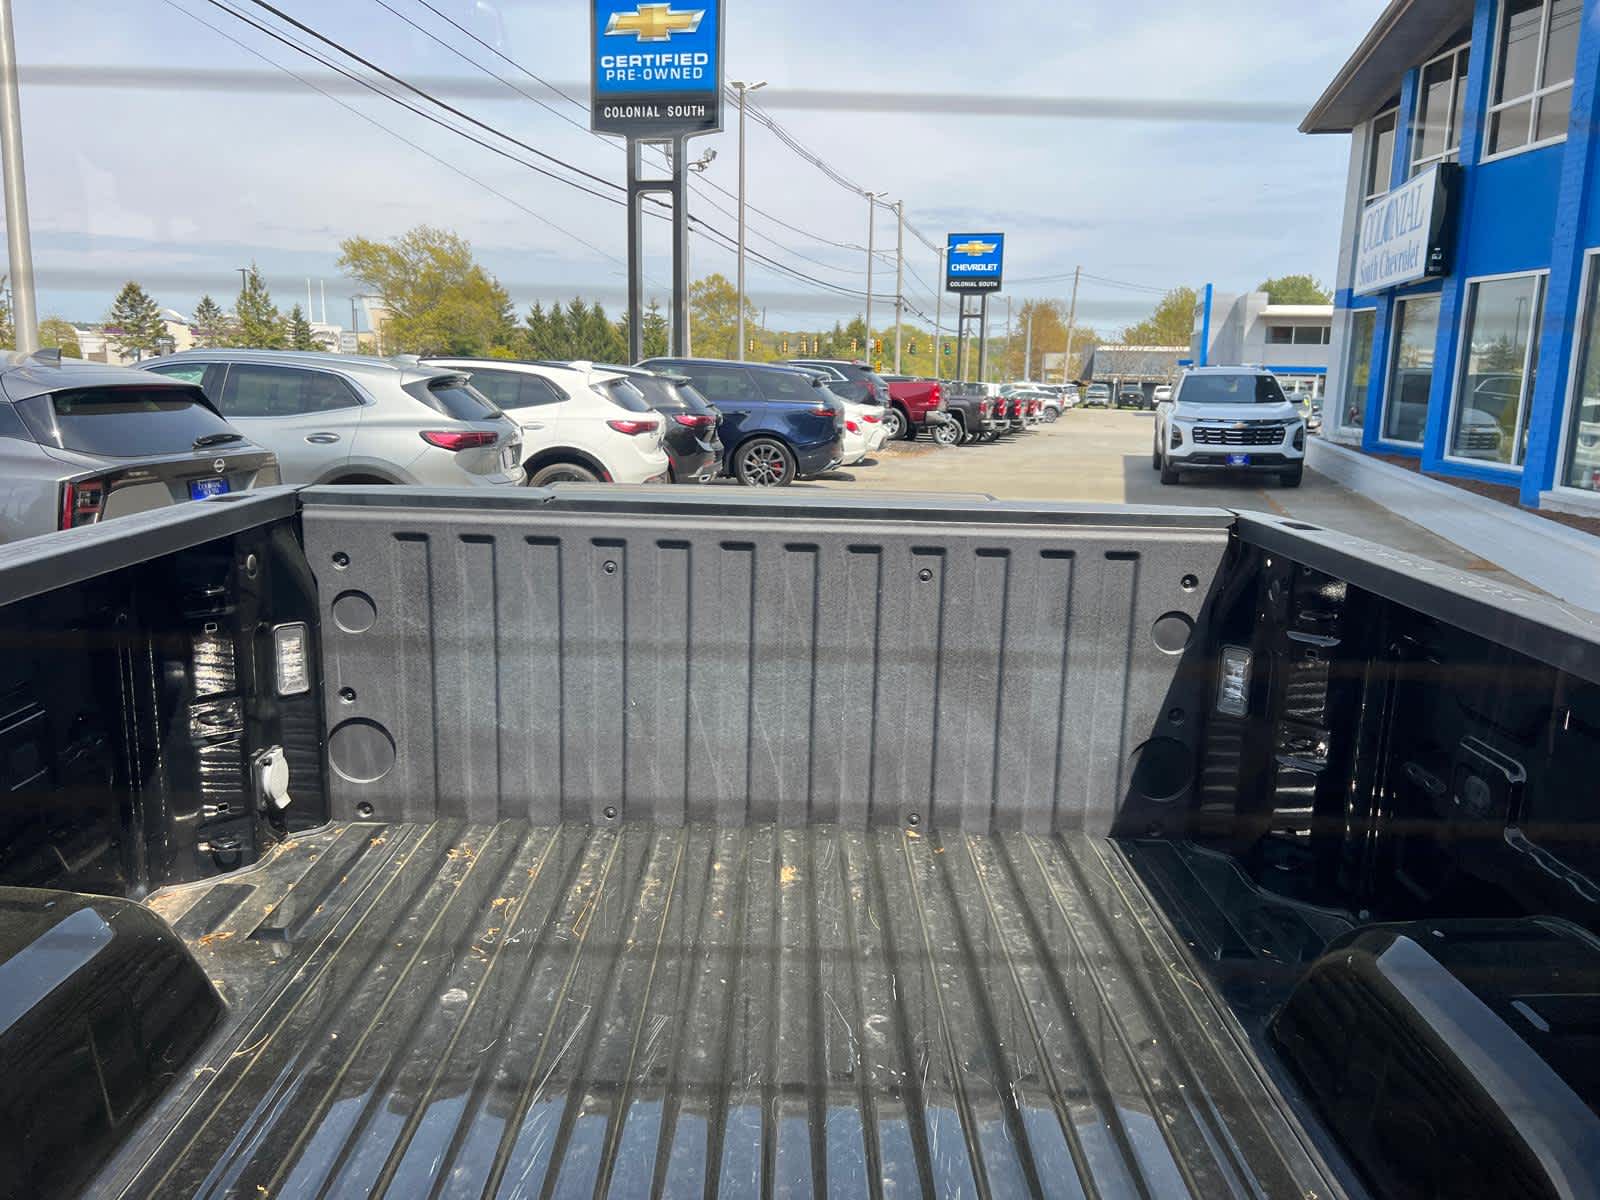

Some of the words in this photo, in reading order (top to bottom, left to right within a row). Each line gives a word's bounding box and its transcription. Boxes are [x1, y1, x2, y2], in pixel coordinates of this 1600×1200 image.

[601, 53, 708, 68] CERTIFIED
[606, 67, 703, 81] PRE-OWNED
[604, 106, 660, 119] COLONIAL
[667, 105, 705, 117] SOUTH
[1379, 238, 1420, 280] Chevrolet
[951, 263, 998, 271] CHEVROLET
